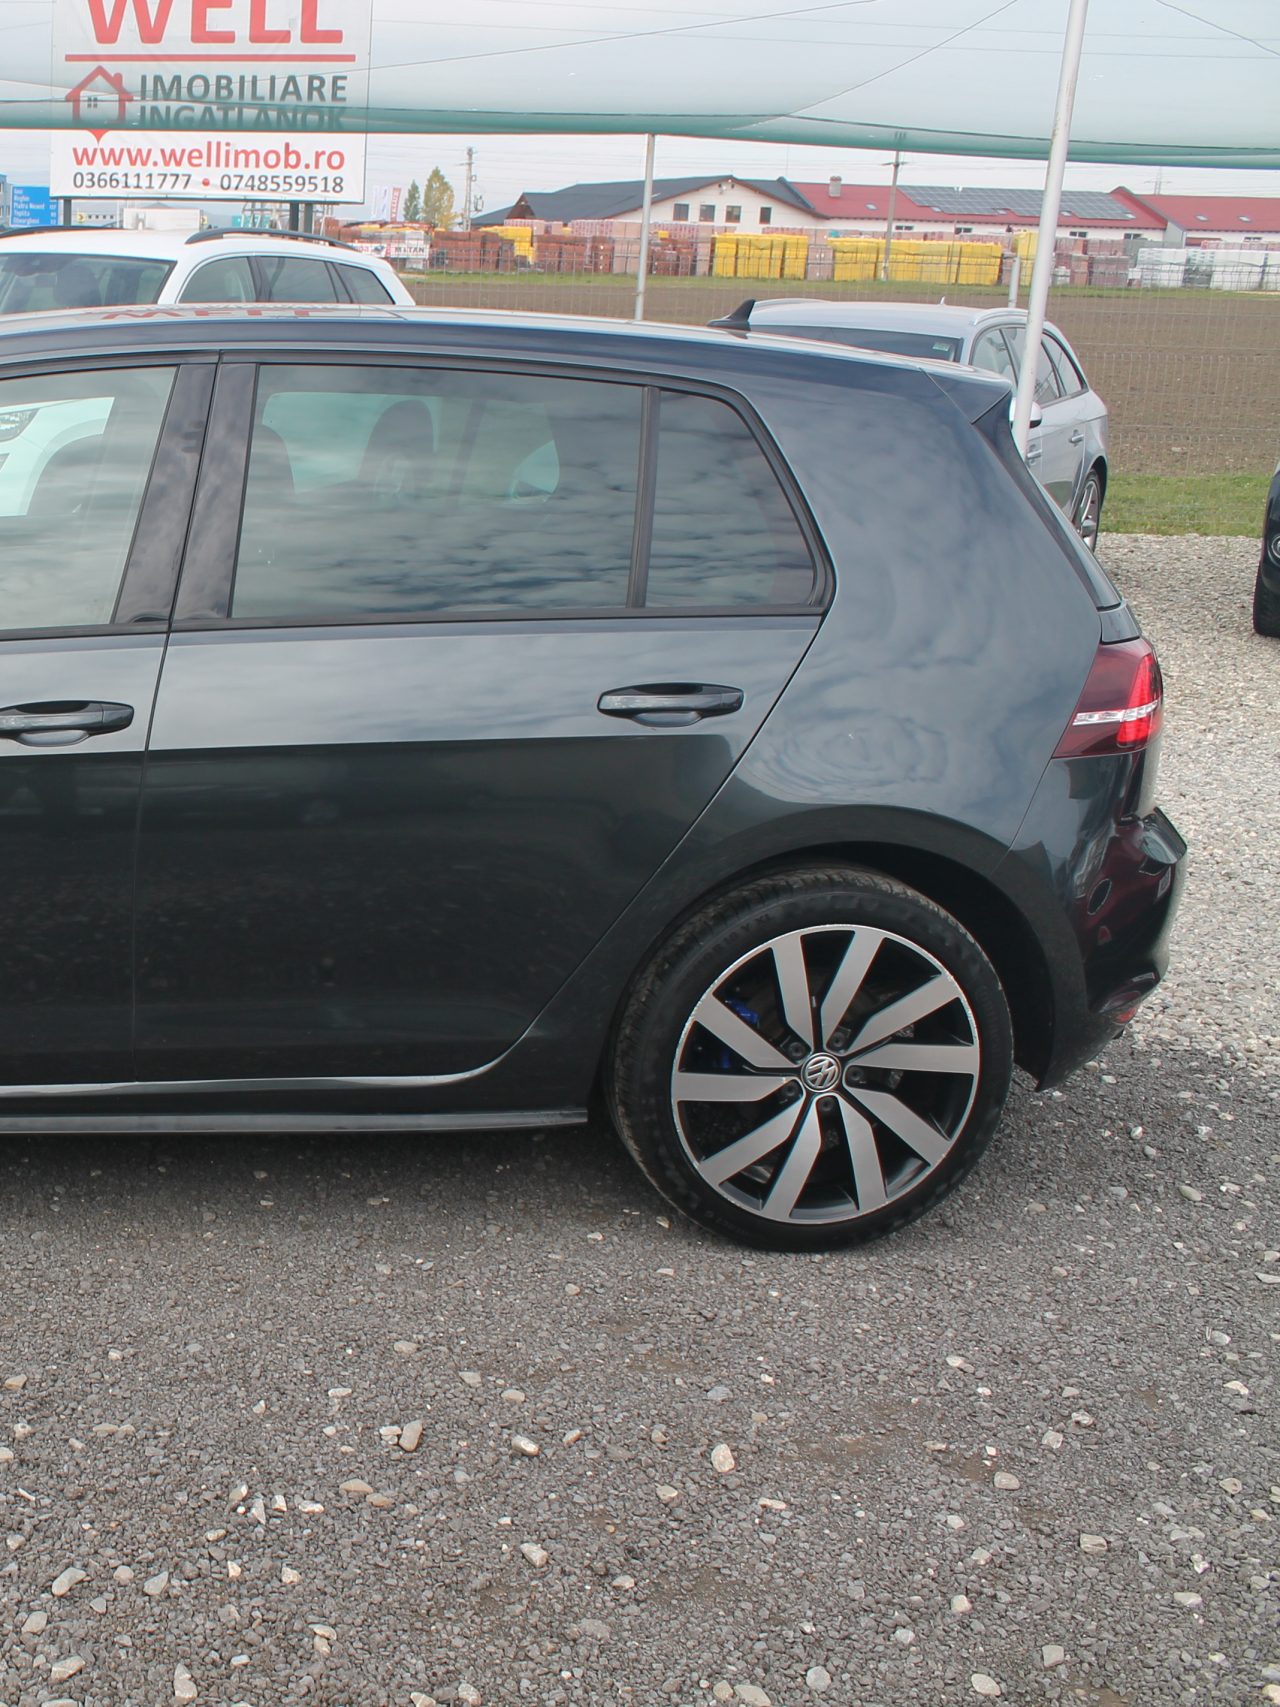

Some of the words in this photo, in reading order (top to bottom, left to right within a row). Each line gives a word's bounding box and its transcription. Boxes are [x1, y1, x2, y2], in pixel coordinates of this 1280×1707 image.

[140, 75, 348, 102] IMOBILIARE
[72, 141, 346, 170] www.wellimob.ro
[73, 172, 192, 190] 0366111777
[220, 174, 344, 193] 0748559518
